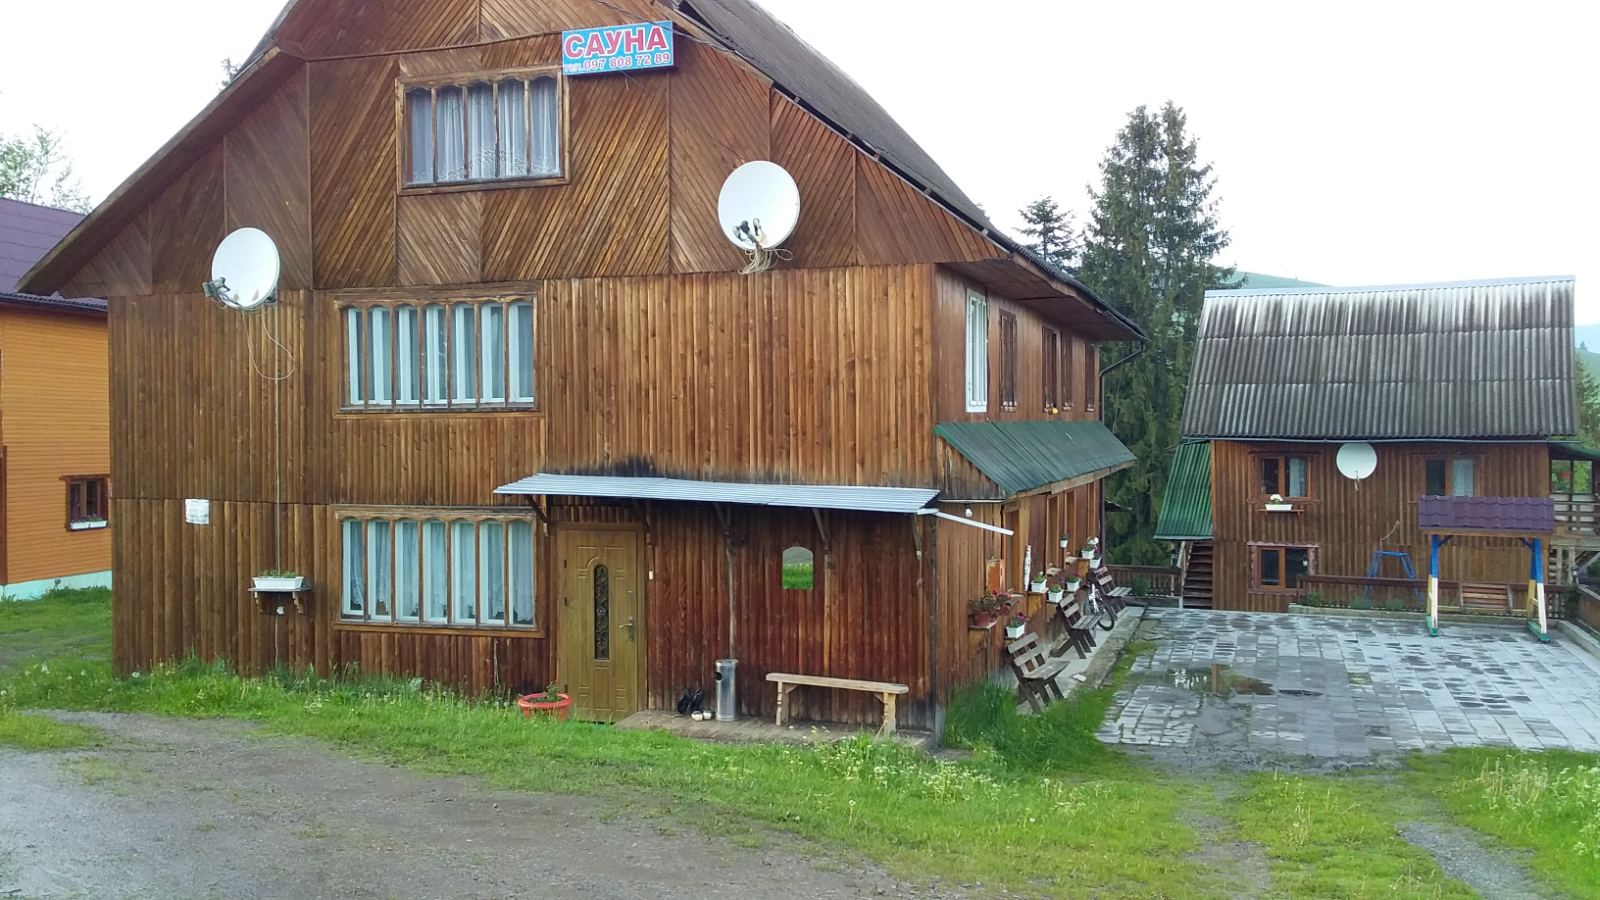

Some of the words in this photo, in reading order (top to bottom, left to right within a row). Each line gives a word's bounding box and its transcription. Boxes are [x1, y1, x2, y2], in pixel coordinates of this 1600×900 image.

[565, 27, 668, 58] САУНА
[610, 57, 632, 67] 808
[636, 55, 651, 65] 72
[654, 52, 670, 64] 89
